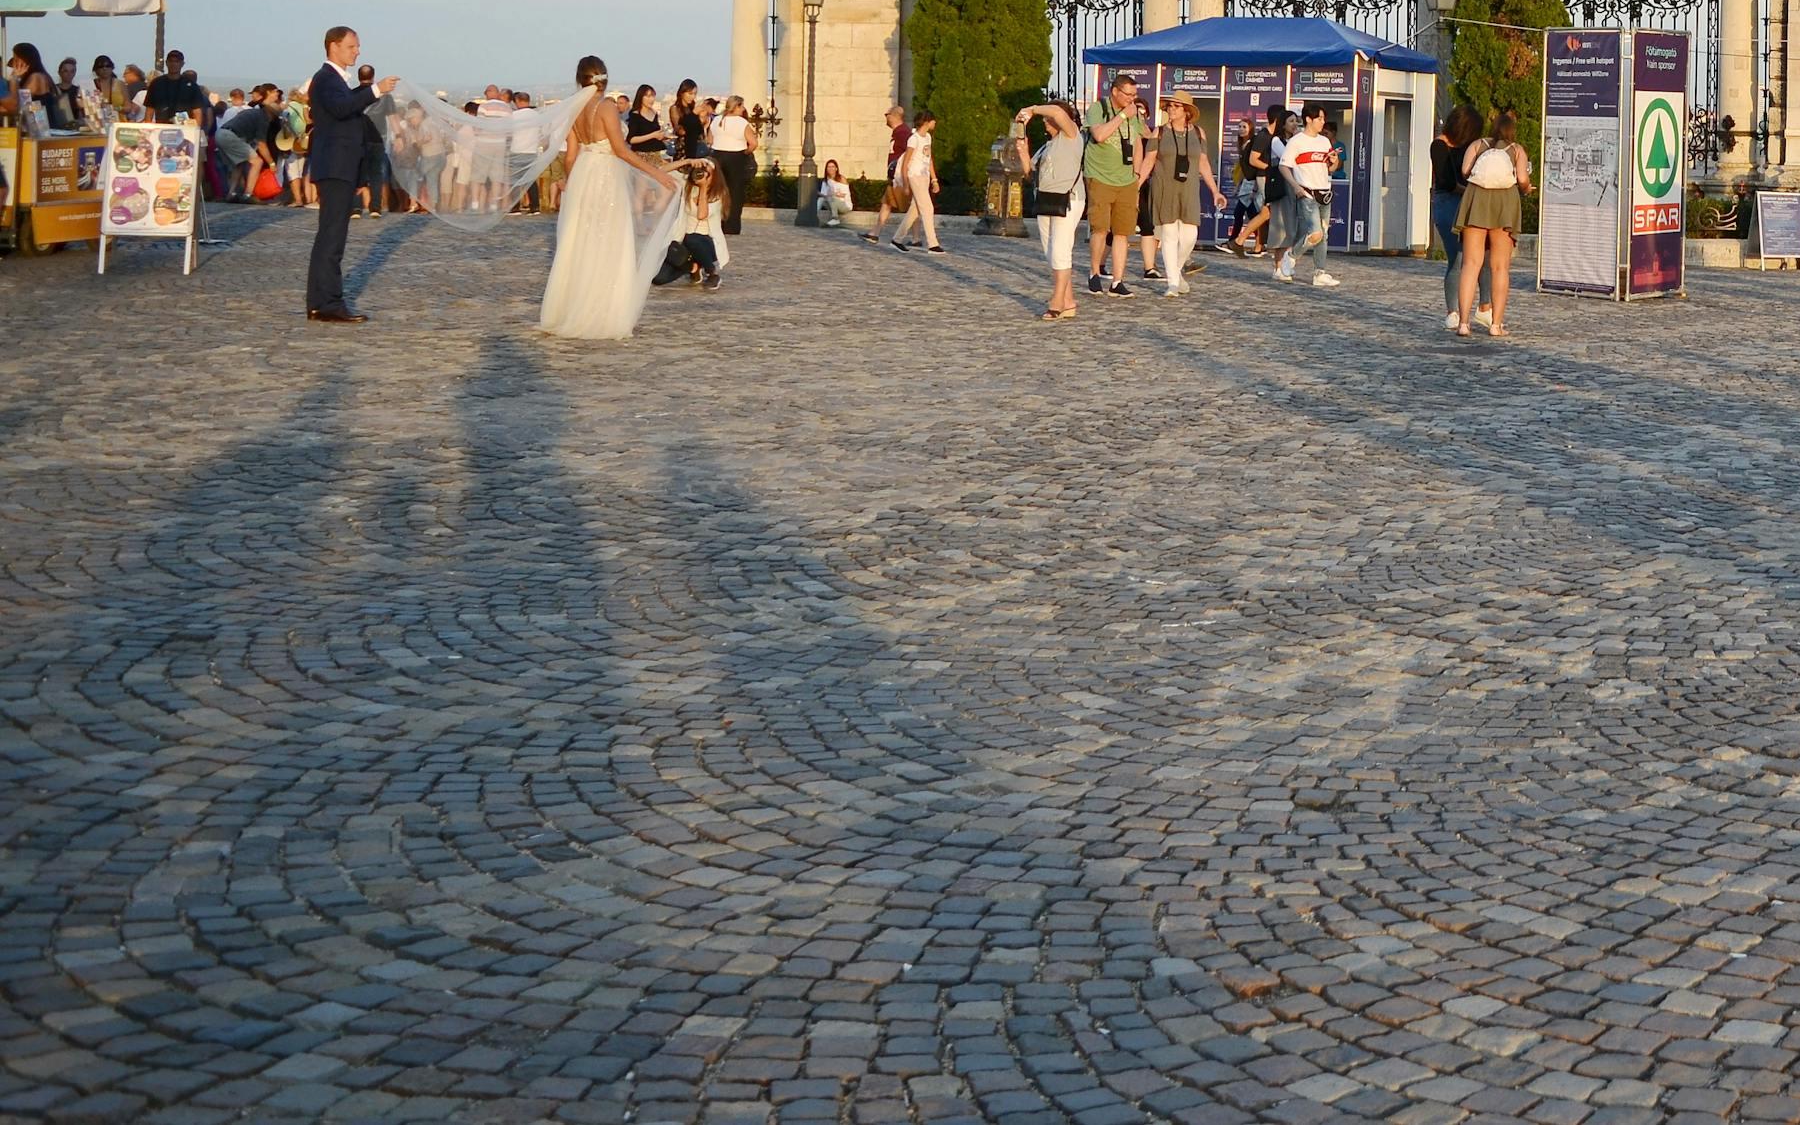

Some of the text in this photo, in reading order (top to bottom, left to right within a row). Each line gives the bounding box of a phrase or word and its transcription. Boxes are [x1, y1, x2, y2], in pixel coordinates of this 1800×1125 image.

[42, 148, 74, 159] BUDAPEST
[41, 177, 51, 185] SEE
[41, 185, 54, 193] SAVE
[1634, 208, 1679, 229] SPAR
